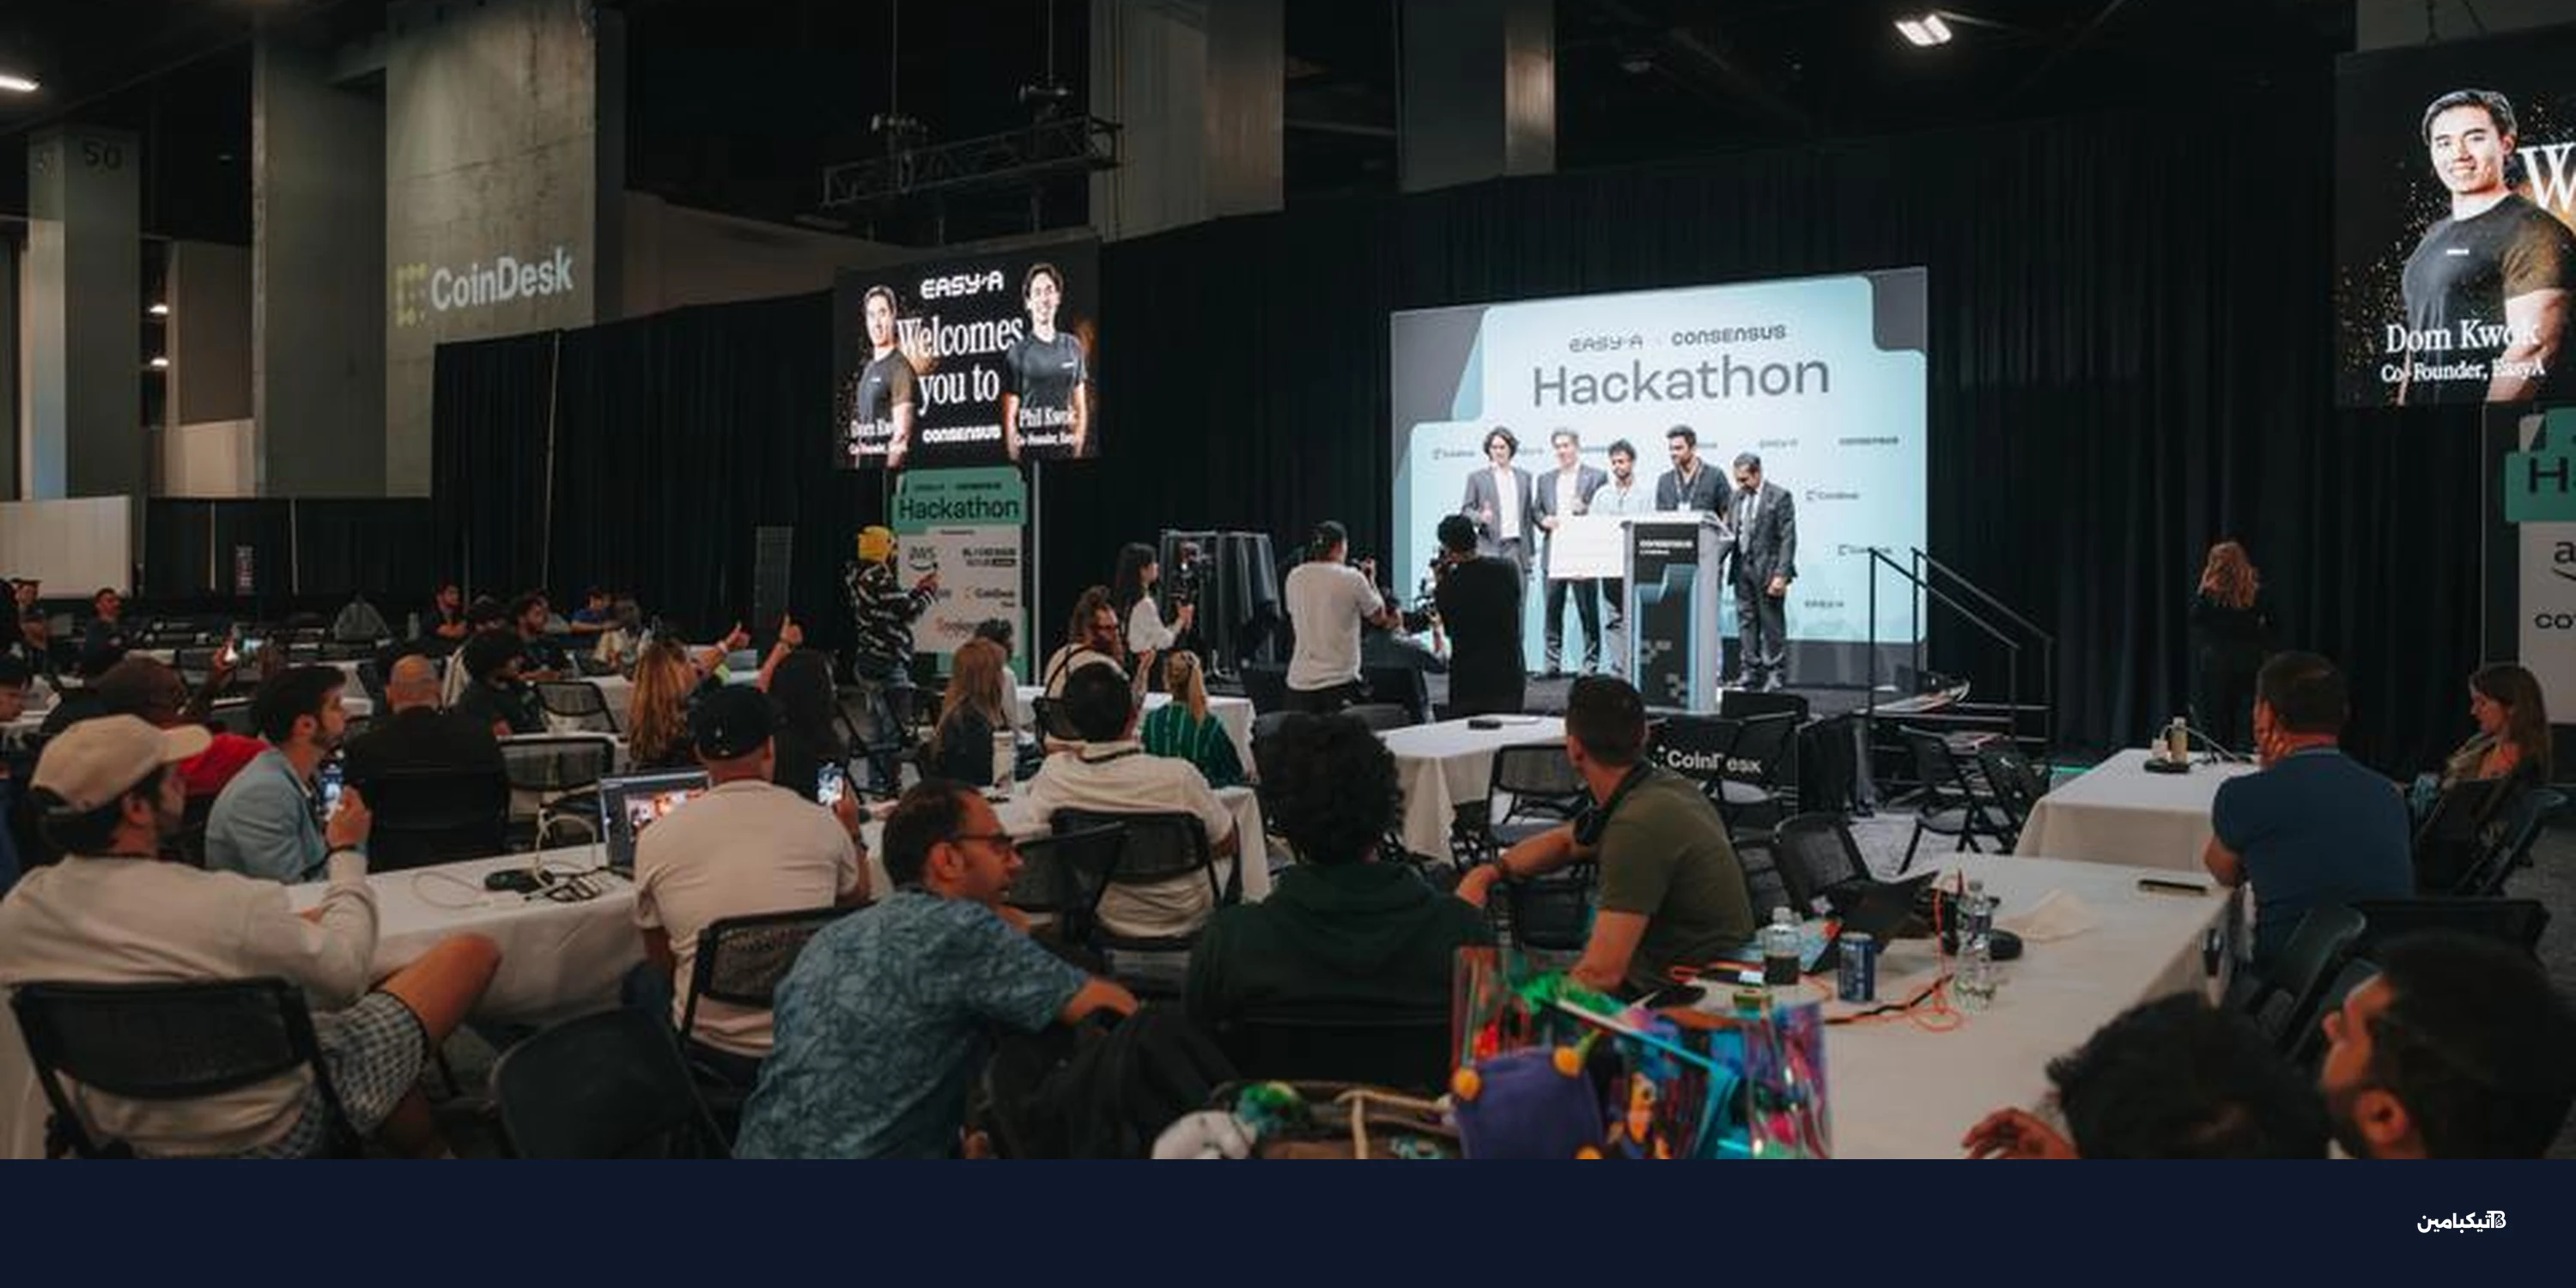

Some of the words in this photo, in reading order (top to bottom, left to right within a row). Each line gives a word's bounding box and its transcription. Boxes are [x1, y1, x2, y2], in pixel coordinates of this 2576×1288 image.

[431, 246, 574, 312] CoinDesk
[896, 315, 1024, 358] Welcomes
[1671, 324, 1786, 346] CONSENSUS
[2385, 322, 2453, 354] Dom
[918, 373, 967, 416] you
[972, 362, 1000, 403] to
[1534, 354, 1830, 407] Hackathon
[2529, 456, 2576, 494] H
[899, 495, 1019, 520] Hackathon
[2535, 613, 2576, 629] co
